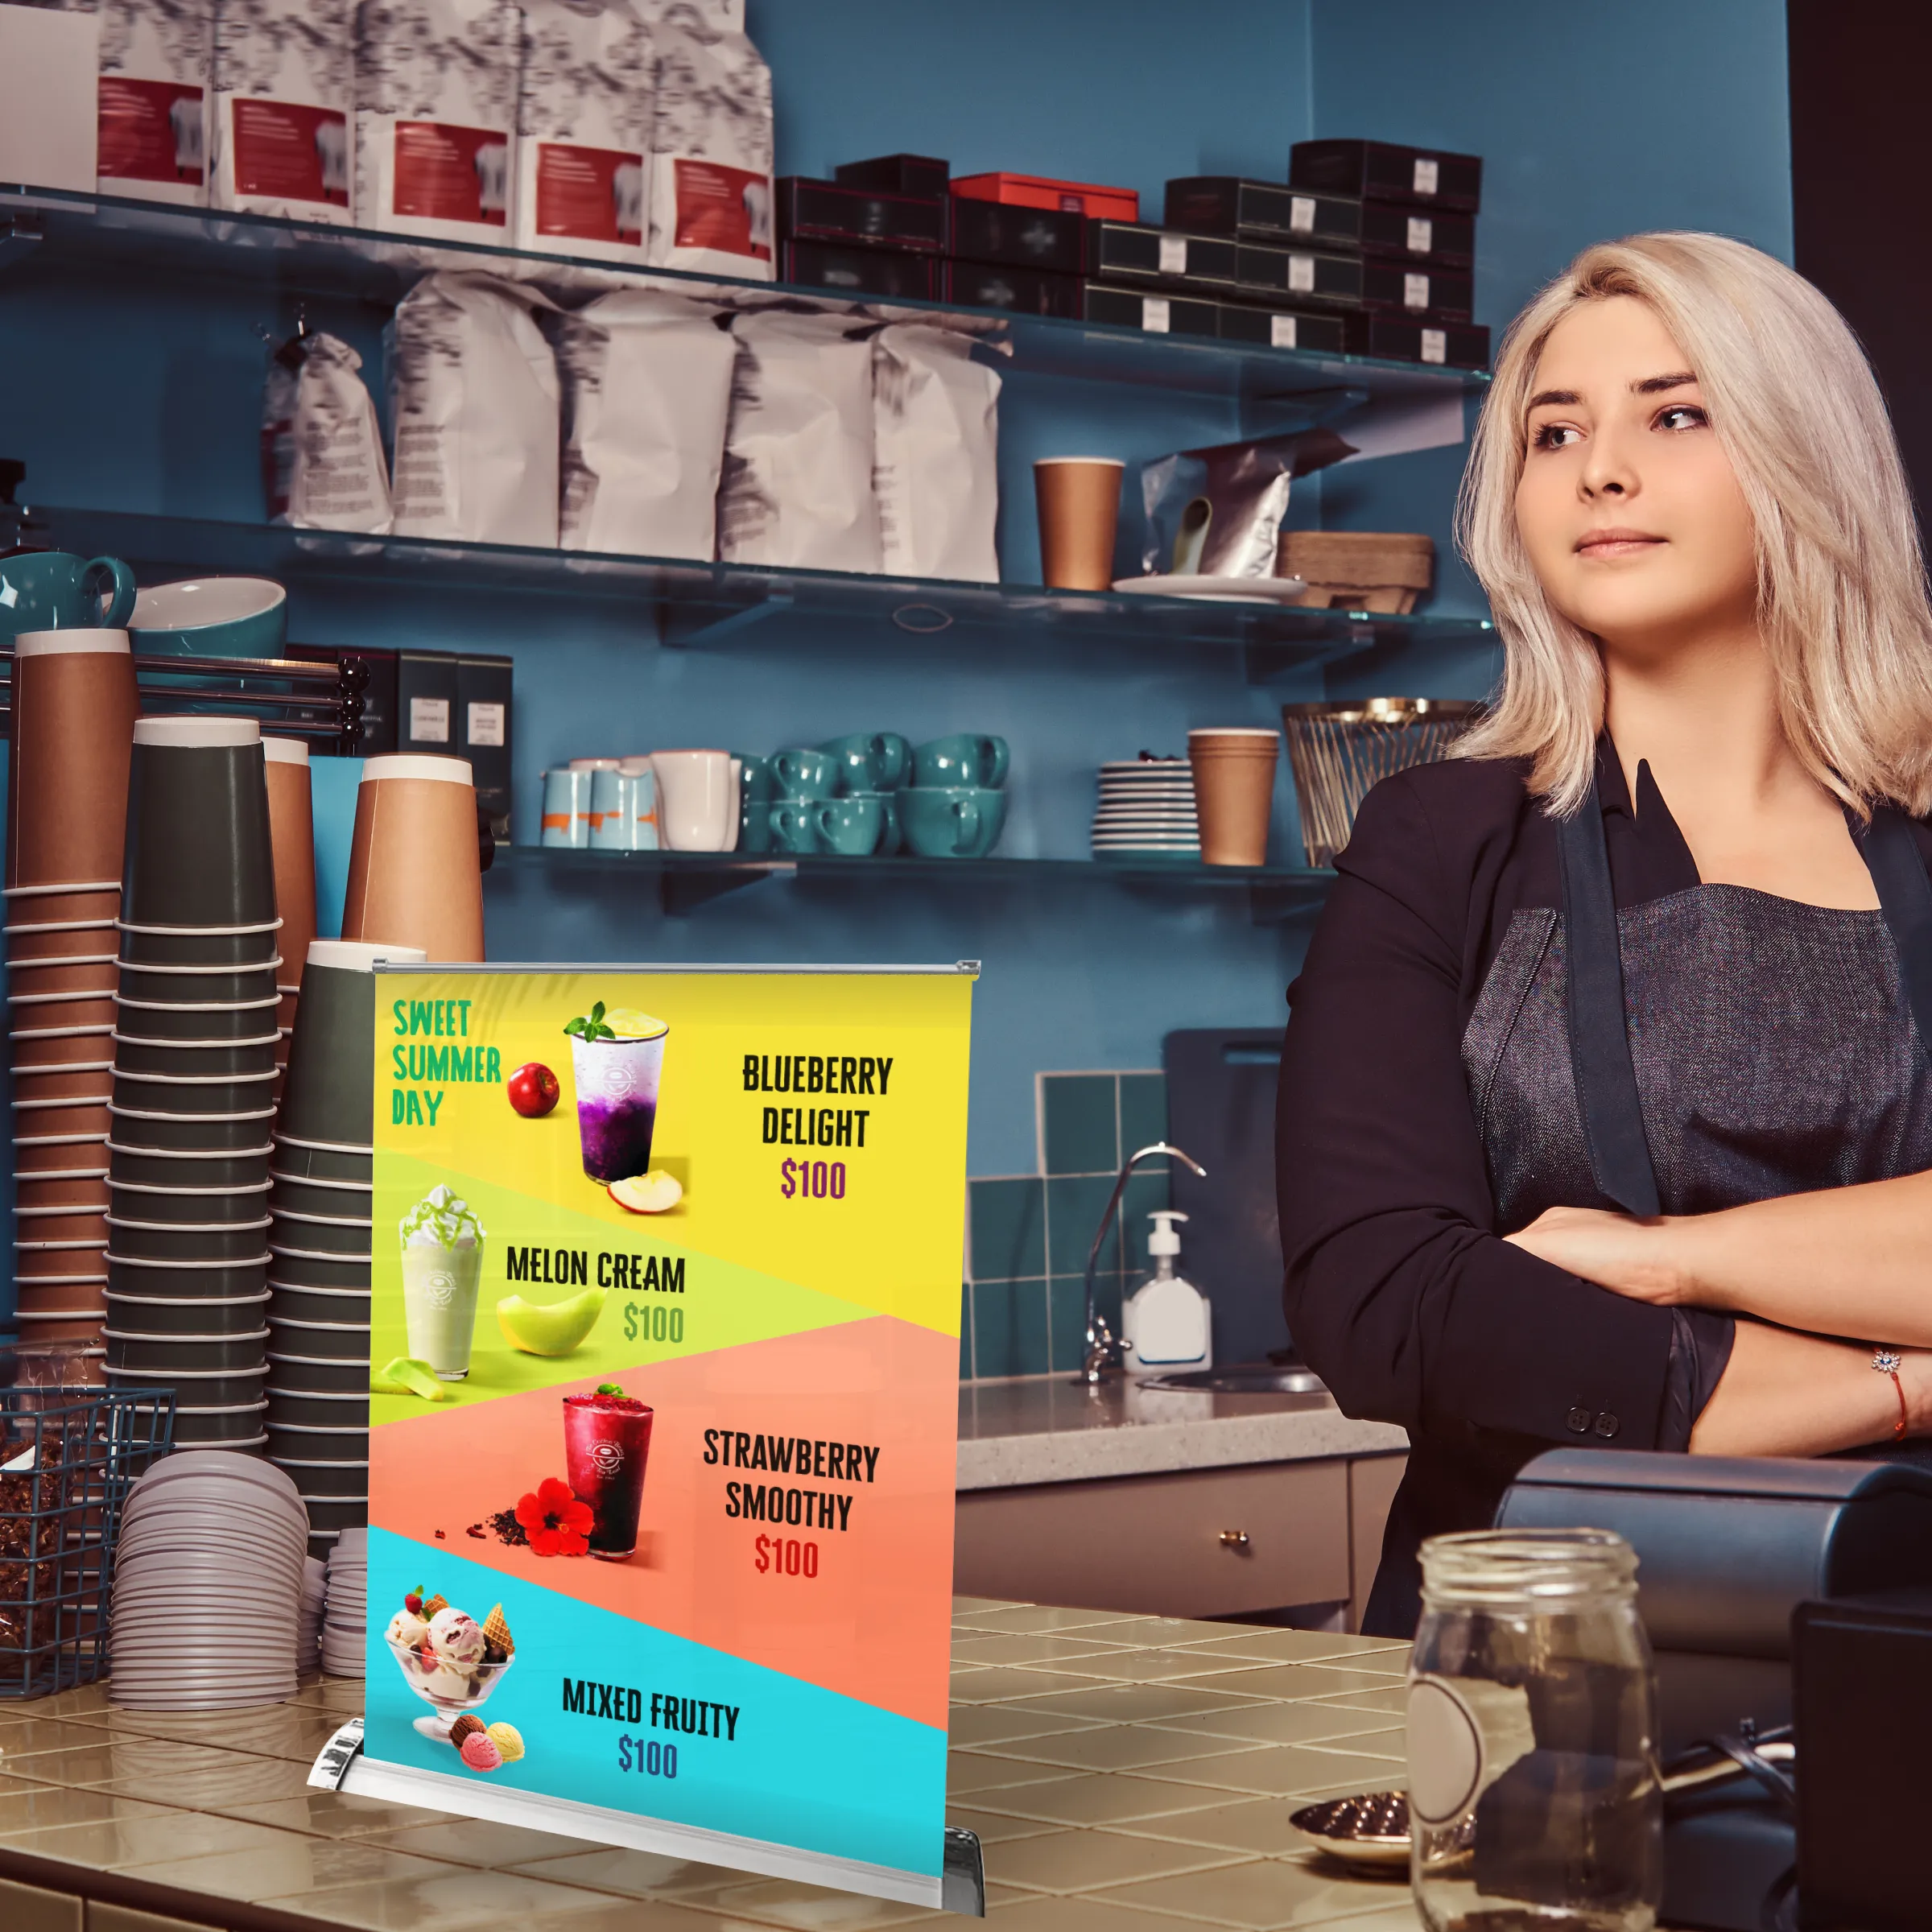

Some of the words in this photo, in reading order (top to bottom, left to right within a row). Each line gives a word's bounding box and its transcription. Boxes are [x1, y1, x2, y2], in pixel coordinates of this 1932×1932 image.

[394, 1000, 471, 1036] SWEET
[393, 1044, 501, 1083] SUMMER
[742, 1055, 894, 1095] BLUEBERRY
[393, 1089, 444, 1126] DAY
[762, 1107, 869, 1147] DELIGHT
[781, 1158, 845, 1199] $100
[507, 1246, 588, 1286] MELON
[597, 1252, 685, 1293] CREAM
[625, 1302, 683, 1343] $100
[704, 1429, 880, 1483] STRAWBERRY
[726, 1481, 853, 1531] SMOOTHY
[755, 1534, 818, 1578] $100
[563, 1678, 642, 1724] MIXED
[650, 1693, 740, 1741] FRUITY
[619, 1734, 677, 1778] $100
